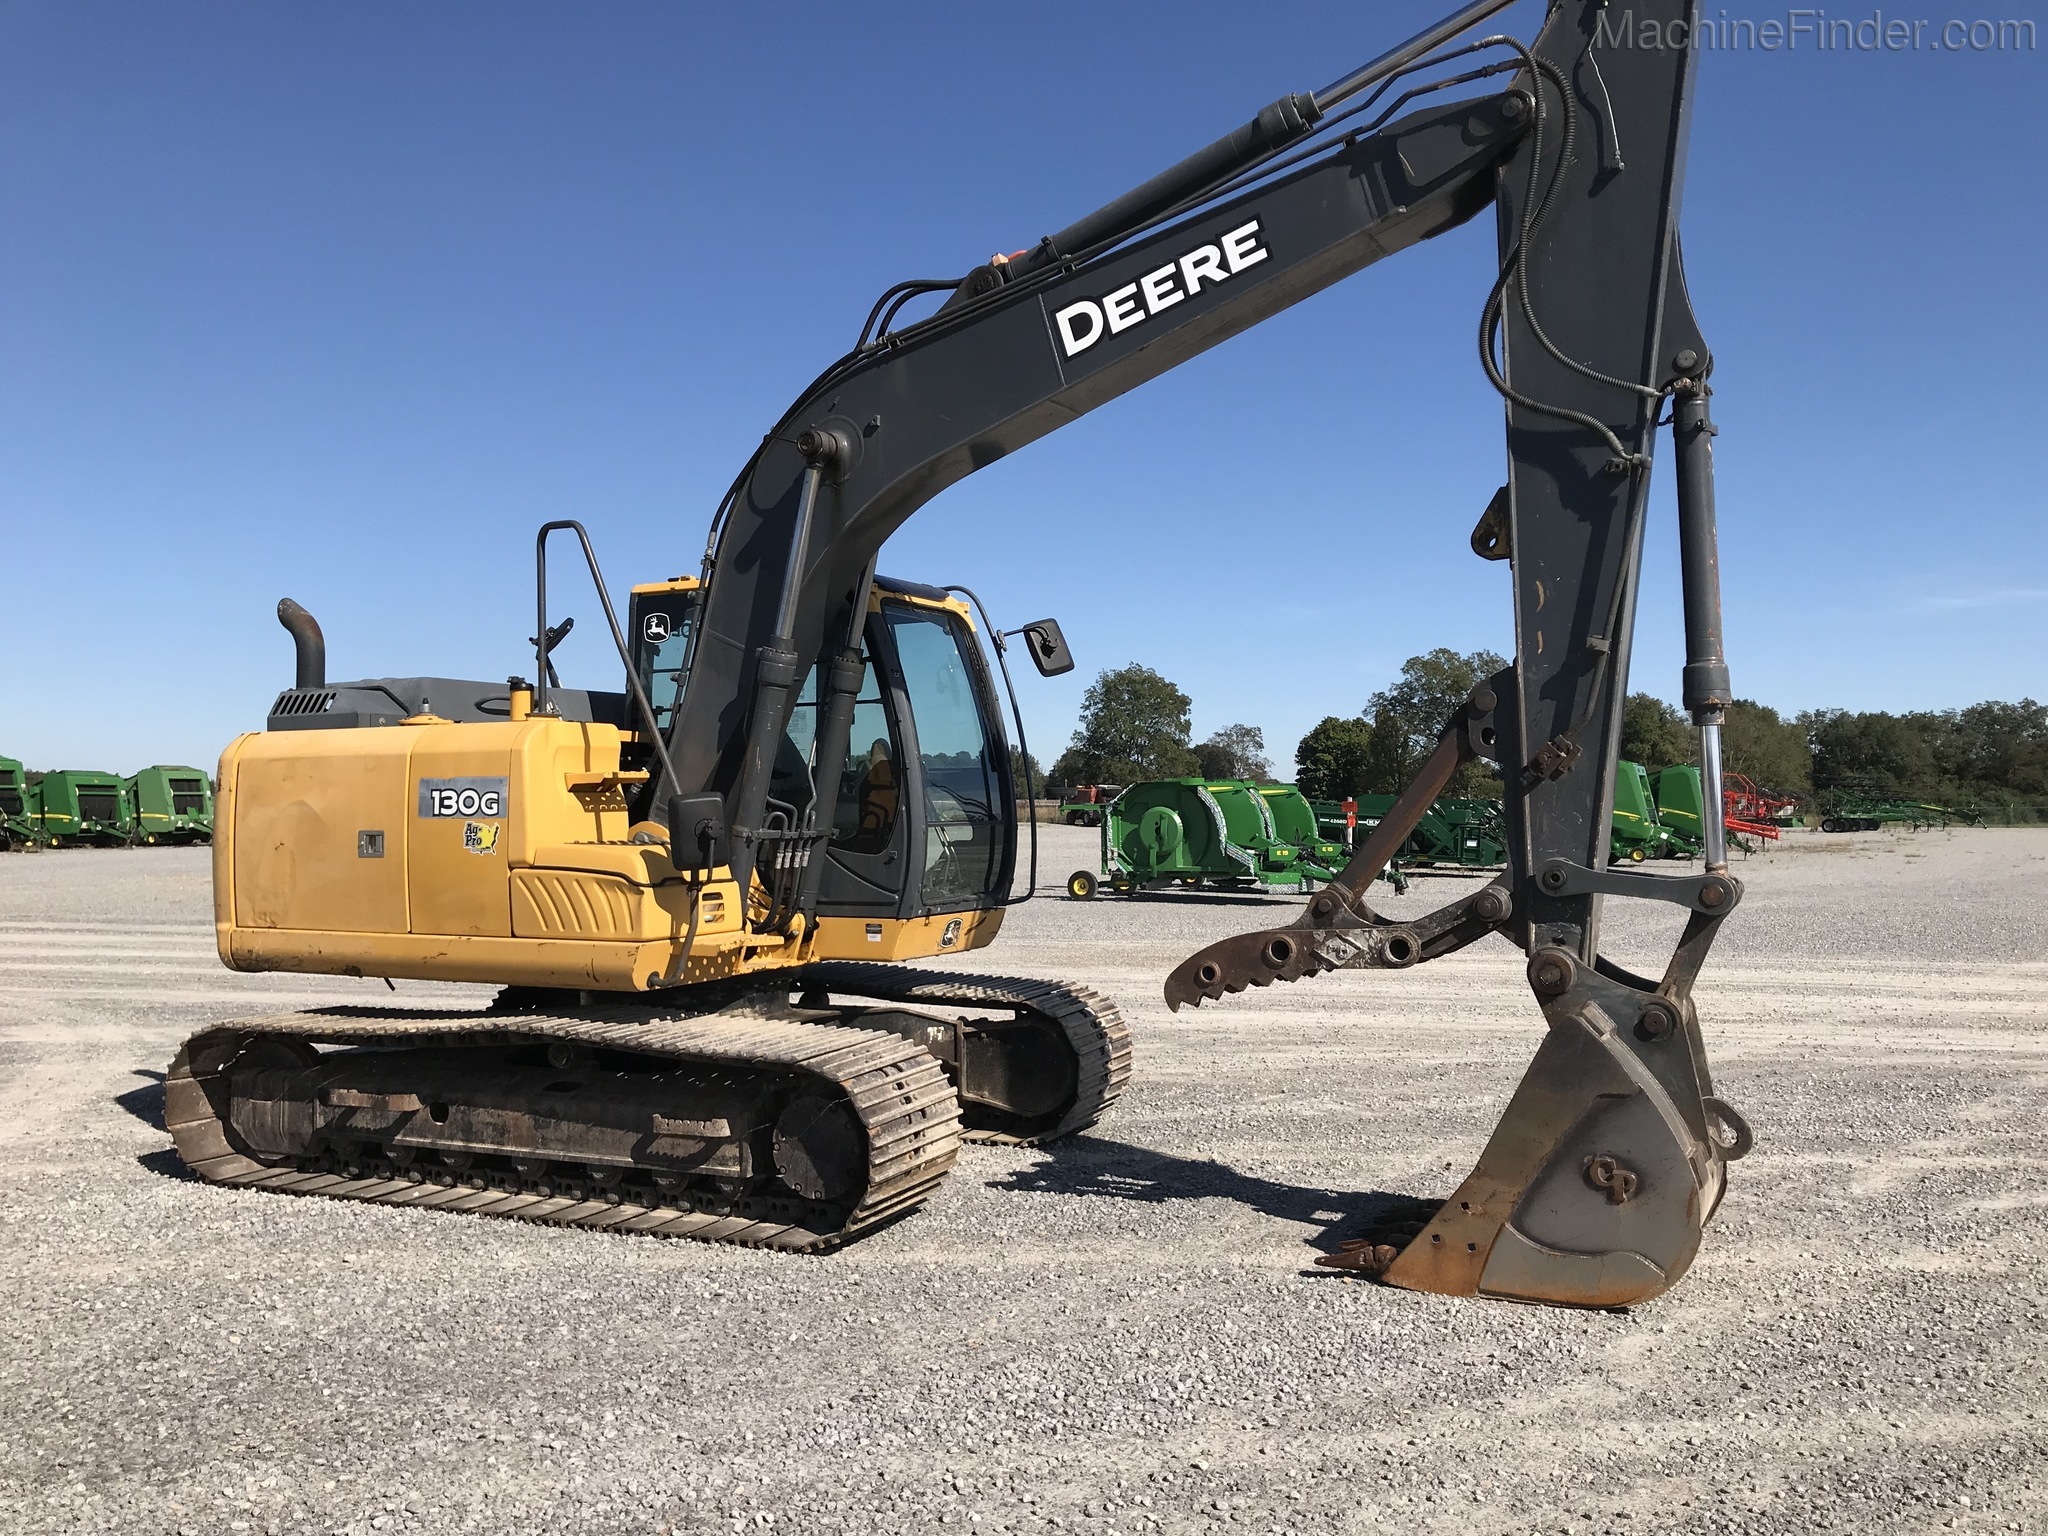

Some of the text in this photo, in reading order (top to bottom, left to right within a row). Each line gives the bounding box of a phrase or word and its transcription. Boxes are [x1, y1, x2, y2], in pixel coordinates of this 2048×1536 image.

[1055, 219, 1268, 357] DEERE
[430, 788, 499, 816] 130G
[465, 834, 482, 846] Pro
